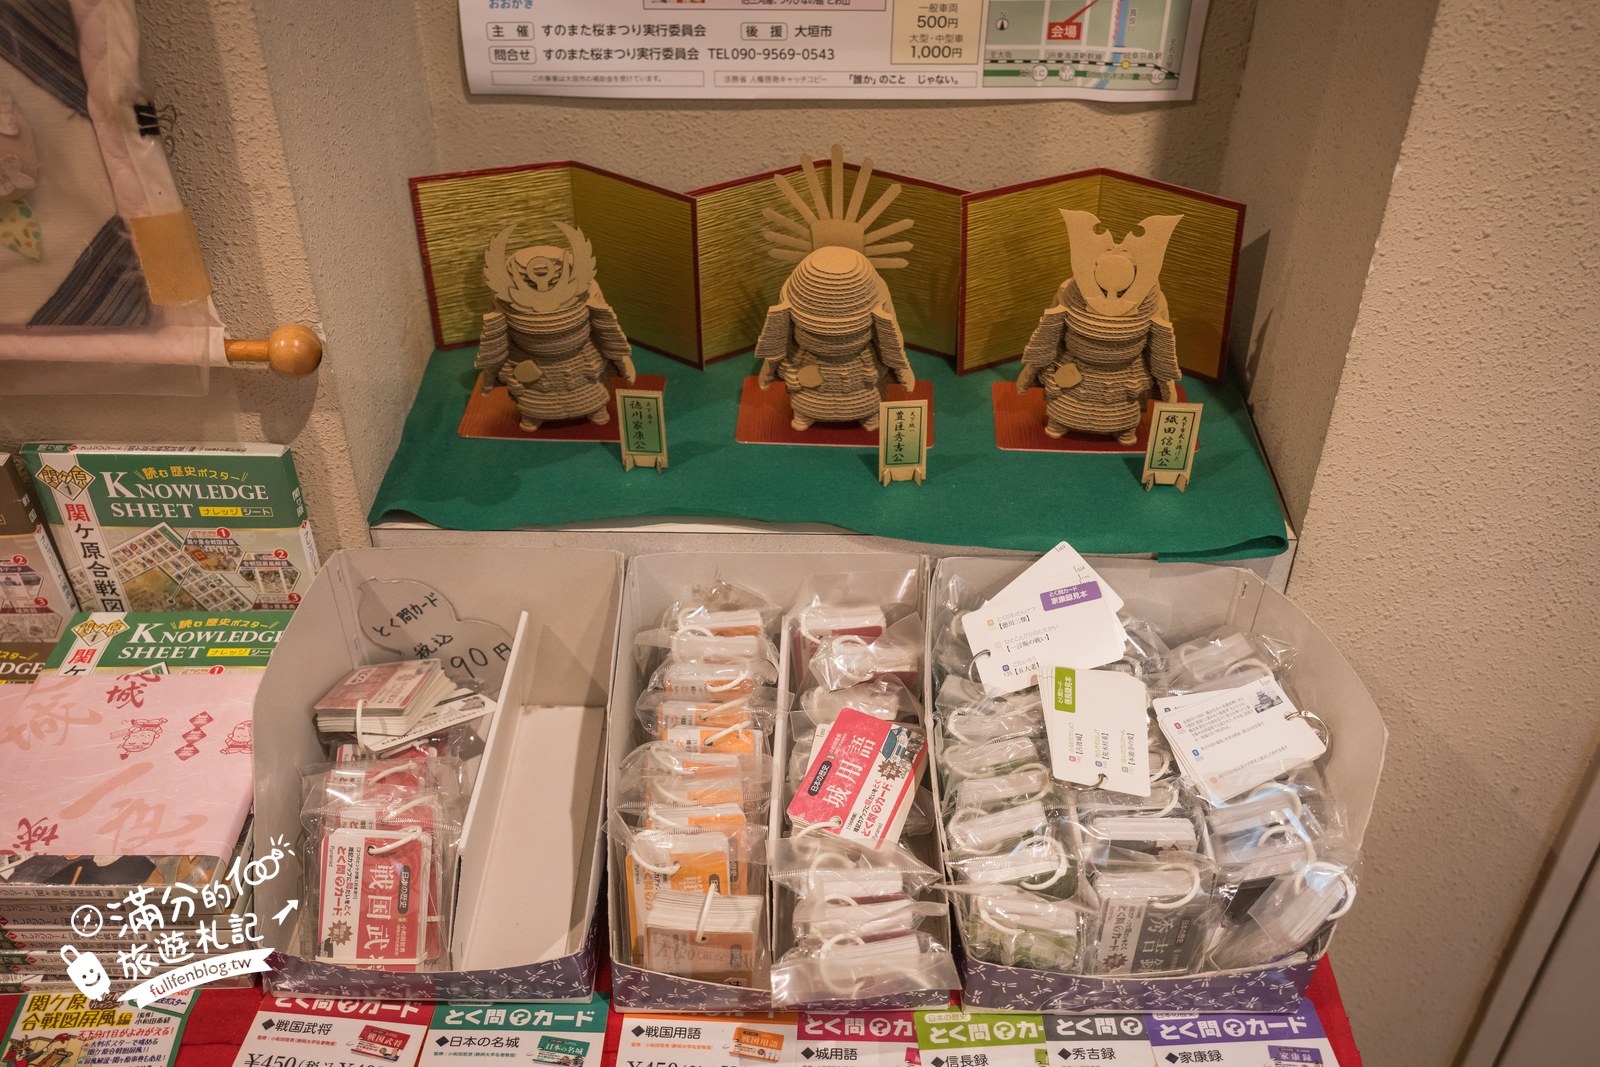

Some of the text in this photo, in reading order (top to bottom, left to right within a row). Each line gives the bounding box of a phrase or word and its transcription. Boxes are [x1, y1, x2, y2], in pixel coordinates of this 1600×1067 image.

[918, 3, 959, 13] 一般車両
[917, 15, 959, 29] 500円
[541, 23, 706, 38] すのまた桜まつり実行委員会
[794, 25, 833, 38] 大垣市
[1051, 25, 1078, 39] 会場
[494, 49, 531, 62] 問合せ
[544, 48, 699, 61] すのまた桜まつり実行委員会
[911, 45, 963, 60] 1,000円
[1157, 414, 1180, 467] 織田信長公
[99, 471, 269, 501] KNOWLEDGE
[109, 502, 195, 519] SHEET
[372, 592, 439, 638] とく問カード
[118, 646, 206, 660] SHEET
[413, 633, 455, 660] 税込
[445, 643, 513, 680] 90円
[822, 734, 877, 809] 城用語
[275, 1019, 333, 1036] 戦国武将
[644, 1025, 702, 1040] 戦国用語
[929, 1020, 1045, 1044] とく問?カ
[449, 1036, 521, 1049] 日本の名城
[815, 1047, 858, 1061] 城用語
[944, 1054, 989, 1067] 信長録
[1072, 1047, 1117, 1061] 秀吉録
[1178, 1049, 1225, 1064] 家康録
